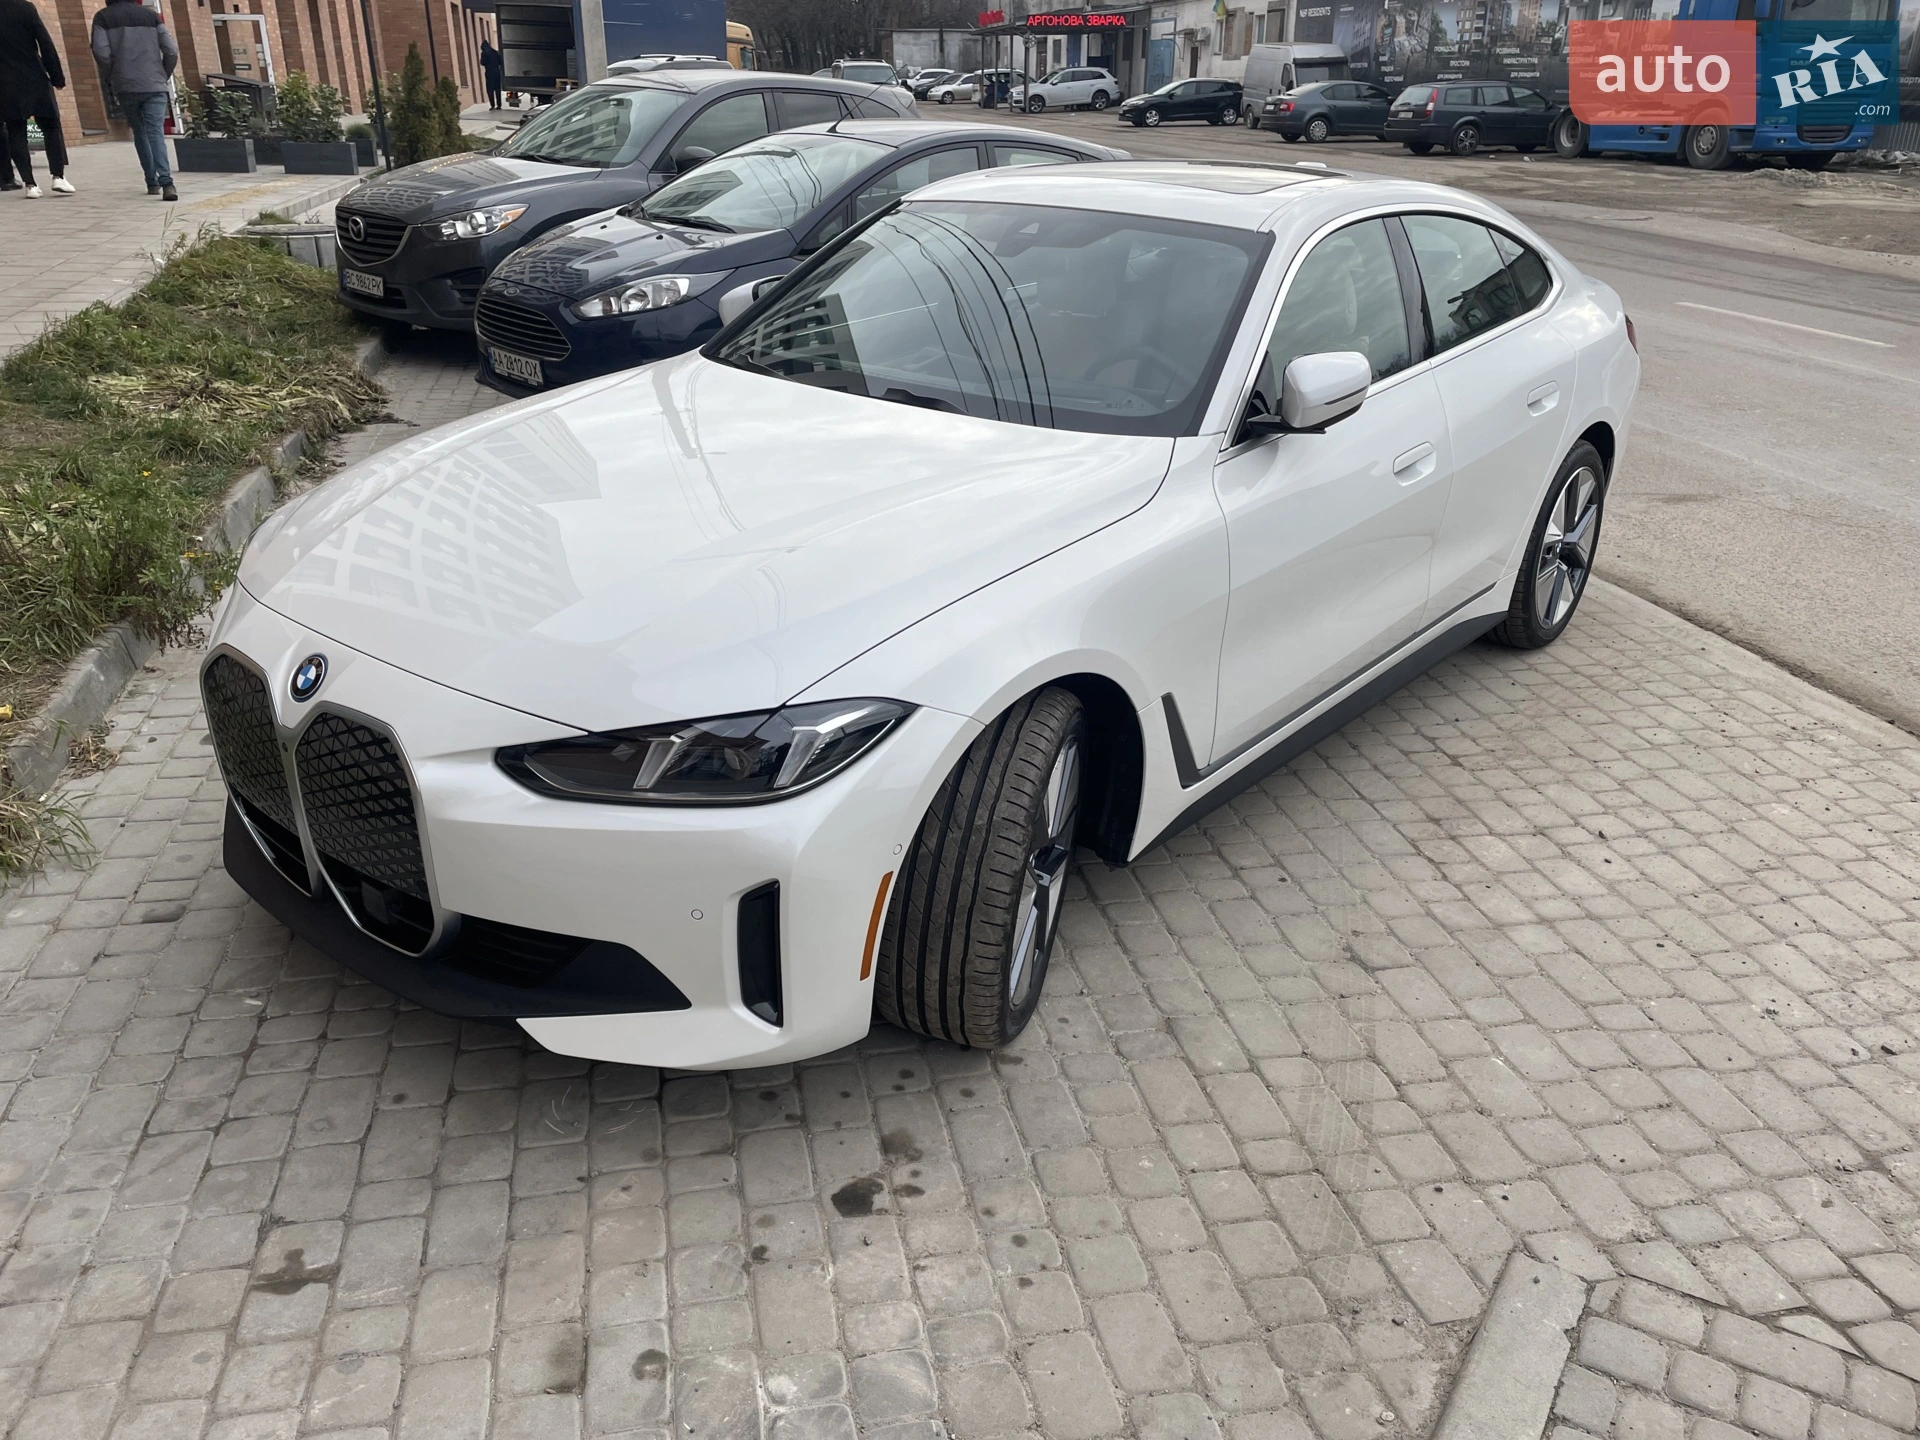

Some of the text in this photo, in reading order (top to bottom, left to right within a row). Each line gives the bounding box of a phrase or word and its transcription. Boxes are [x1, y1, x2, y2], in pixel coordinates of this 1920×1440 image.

[1027, 15, 1126, 26] АРГОНОВА ЗВАРКА
[504, 354, 525, 375] 2812
[525, 360, 540, 380] OX
